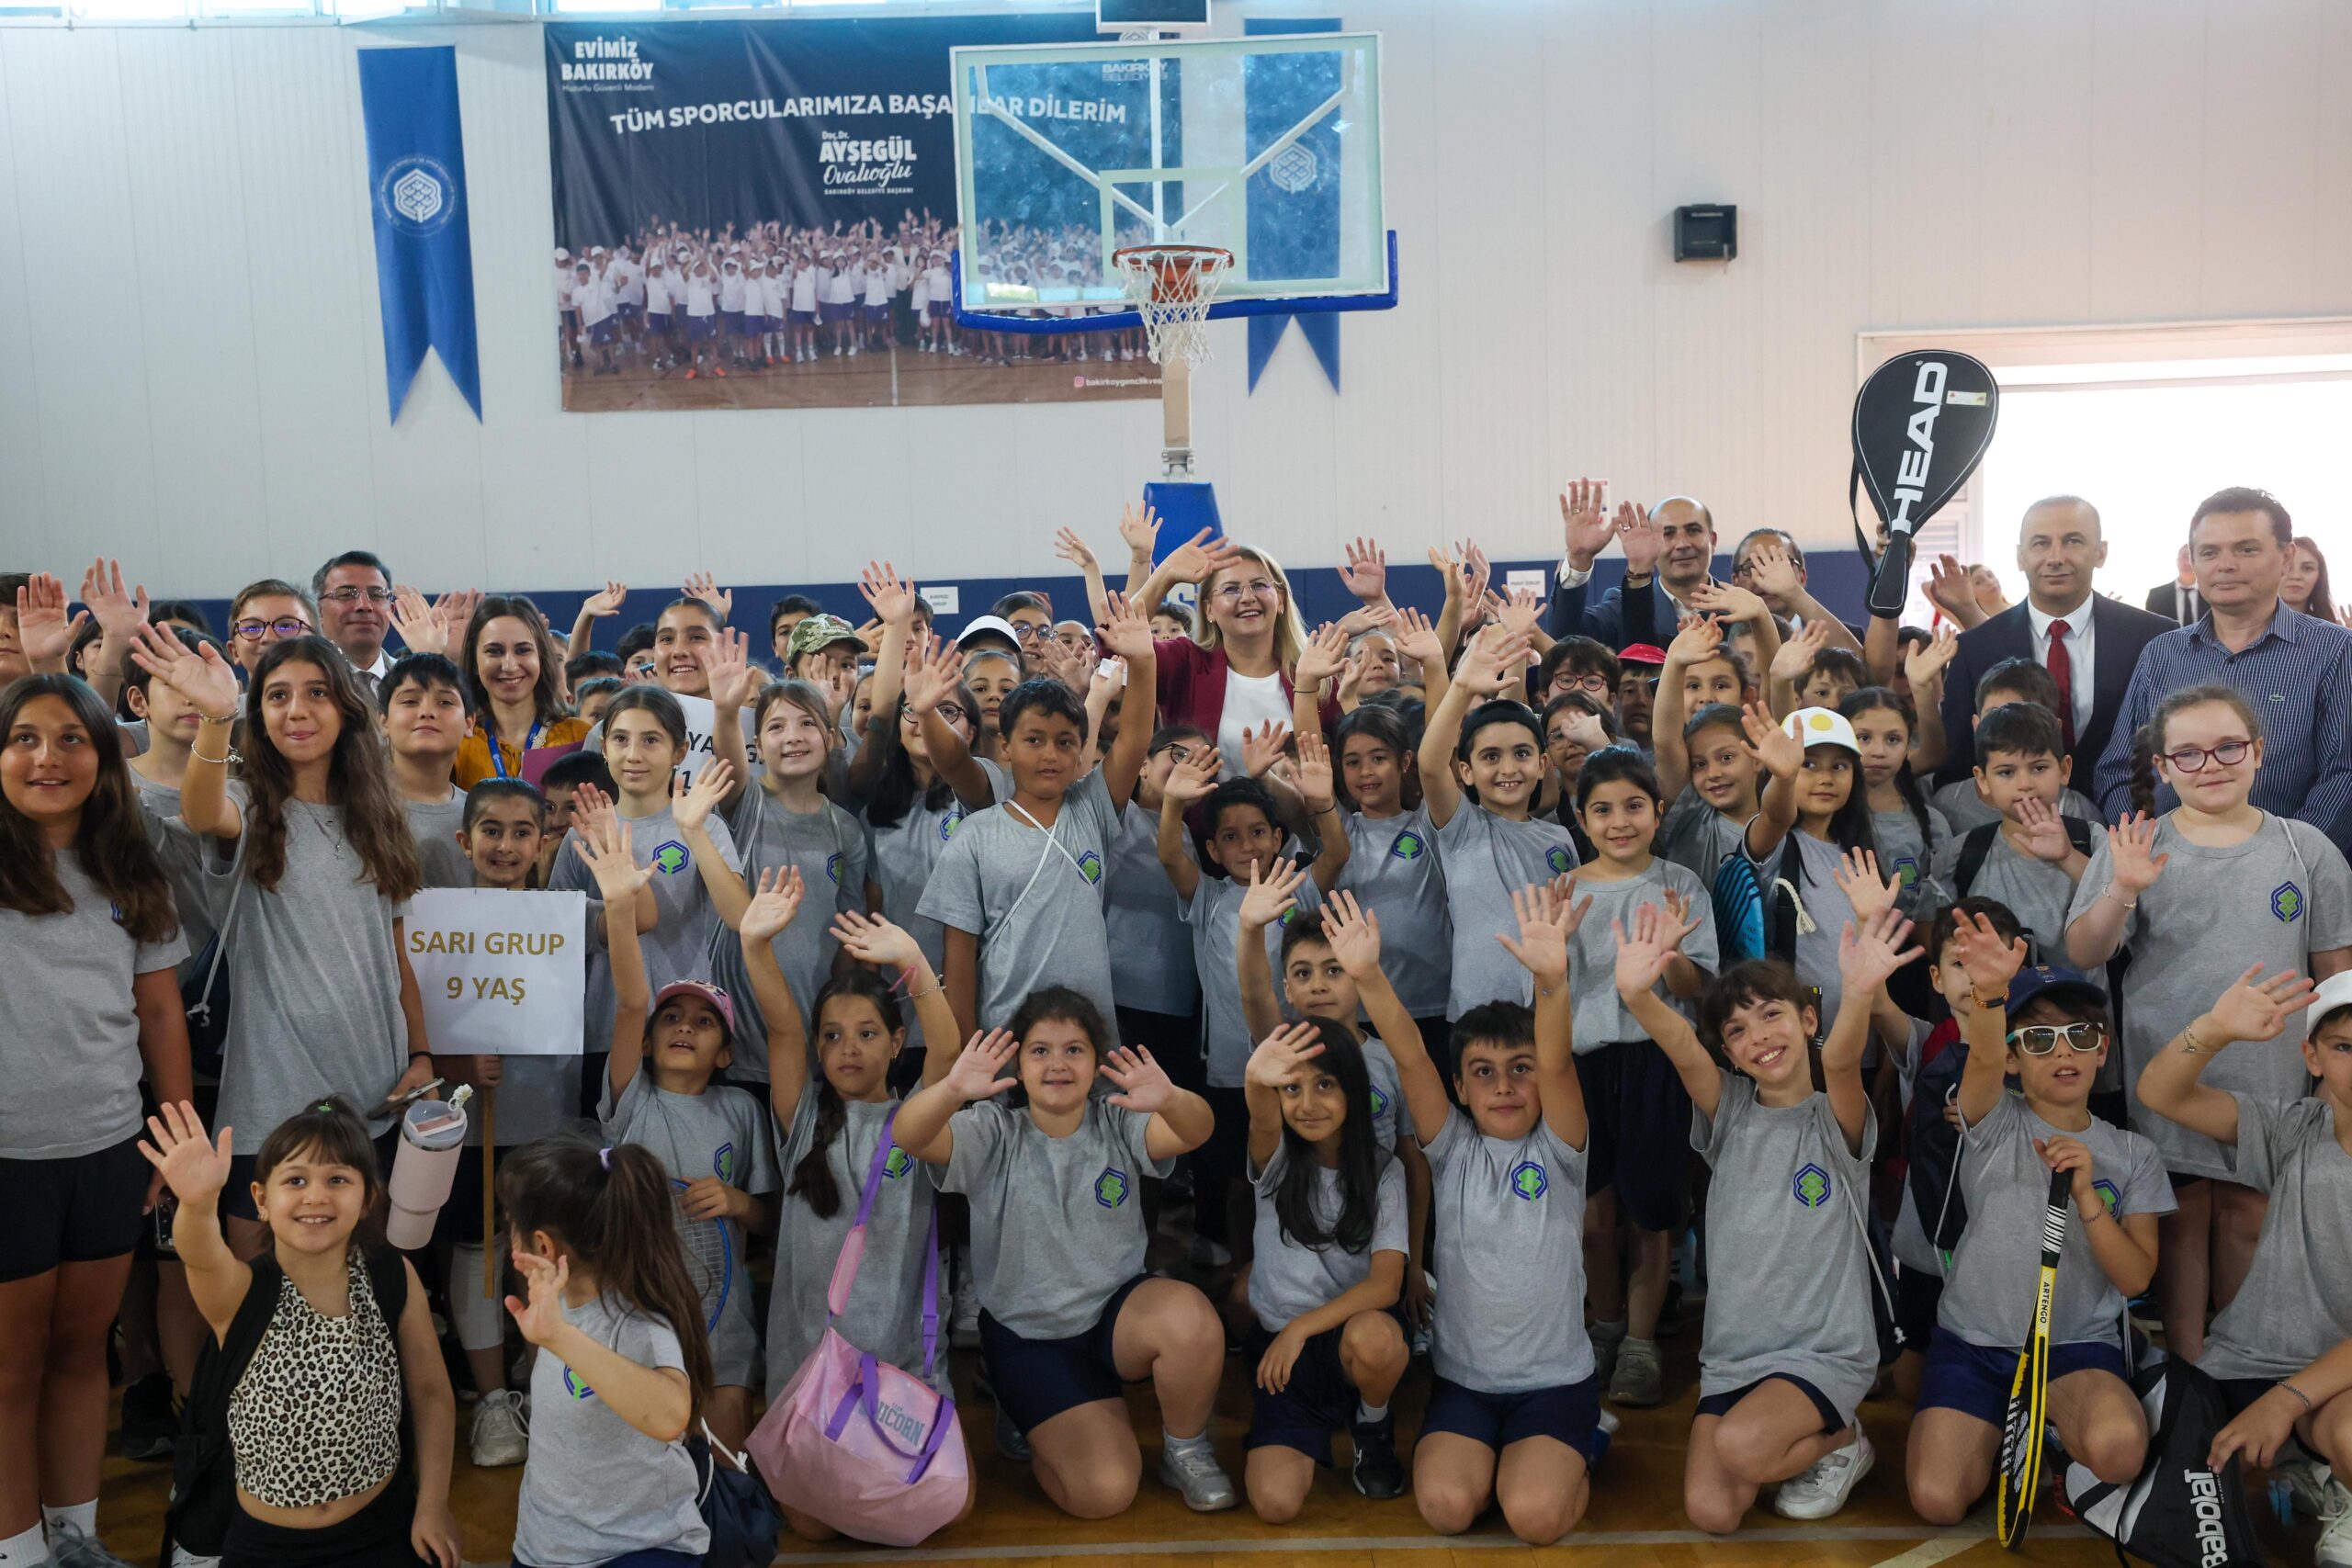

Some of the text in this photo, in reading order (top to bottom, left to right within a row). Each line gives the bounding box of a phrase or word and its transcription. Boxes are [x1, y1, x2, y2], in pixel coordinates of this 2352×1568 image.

[574, 36, 638, 59] EVİMİZ
[561, 58, 654, 81] BAKIRKÖY
[1102, 62, 1169, 73] BAKIRKY
[609, 94, 1126, 134] TÜM SPORCULARIMIZA BAŞAILAR DİLERİM
[819, 135, 917, 166] AYŞEGÜL
[823, 160, 912, 187] Ovalıoğlu
[1891, 361, 1948, 535] HEAD
[410, 931, 565, 956] SARI GRUP
[447, 976, 526, 1006] 9 YAŞ
[2040, 1281, 2051, 1324] ARTENGO
